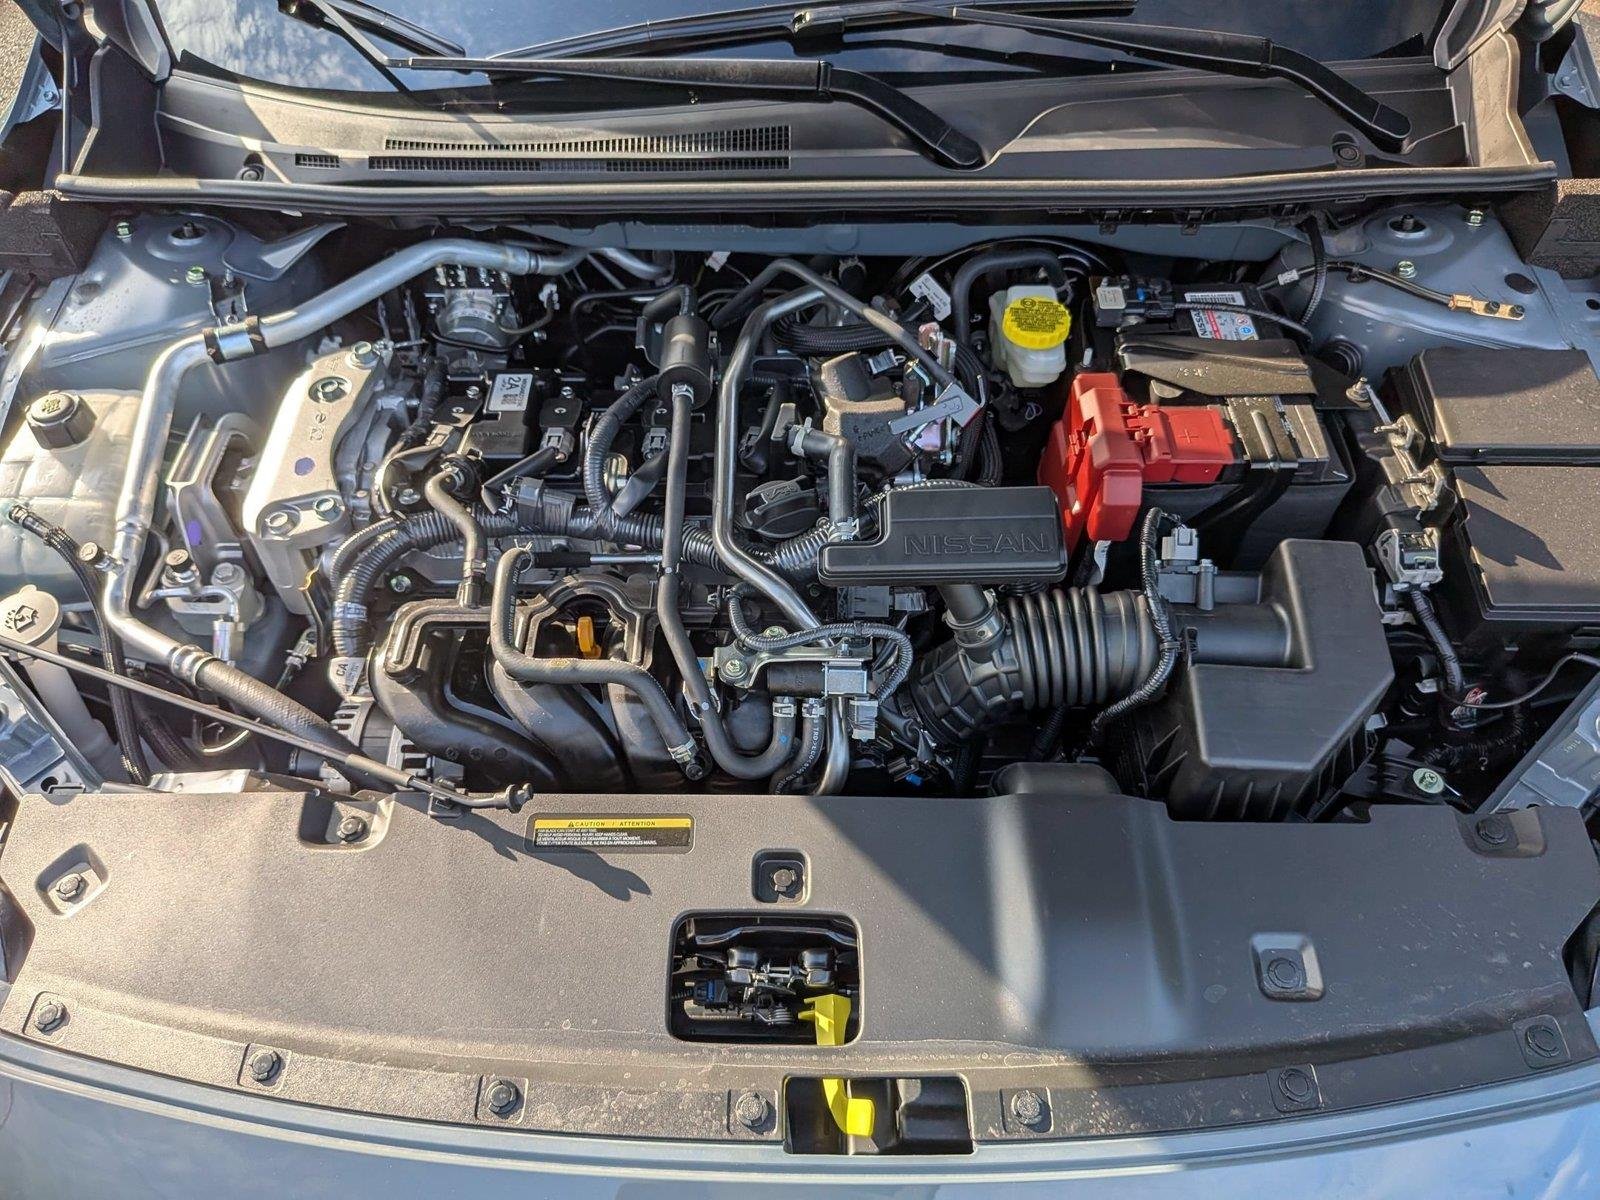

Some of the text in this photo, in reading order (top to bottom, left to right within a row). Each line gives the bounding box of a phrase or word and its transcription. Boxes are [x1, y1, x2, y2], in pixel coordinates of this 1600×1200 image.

[506, 376, 521, 391] 2A
[904, 532, 1051, 556] NISSAN
[335, 663, 348, 677] CA
